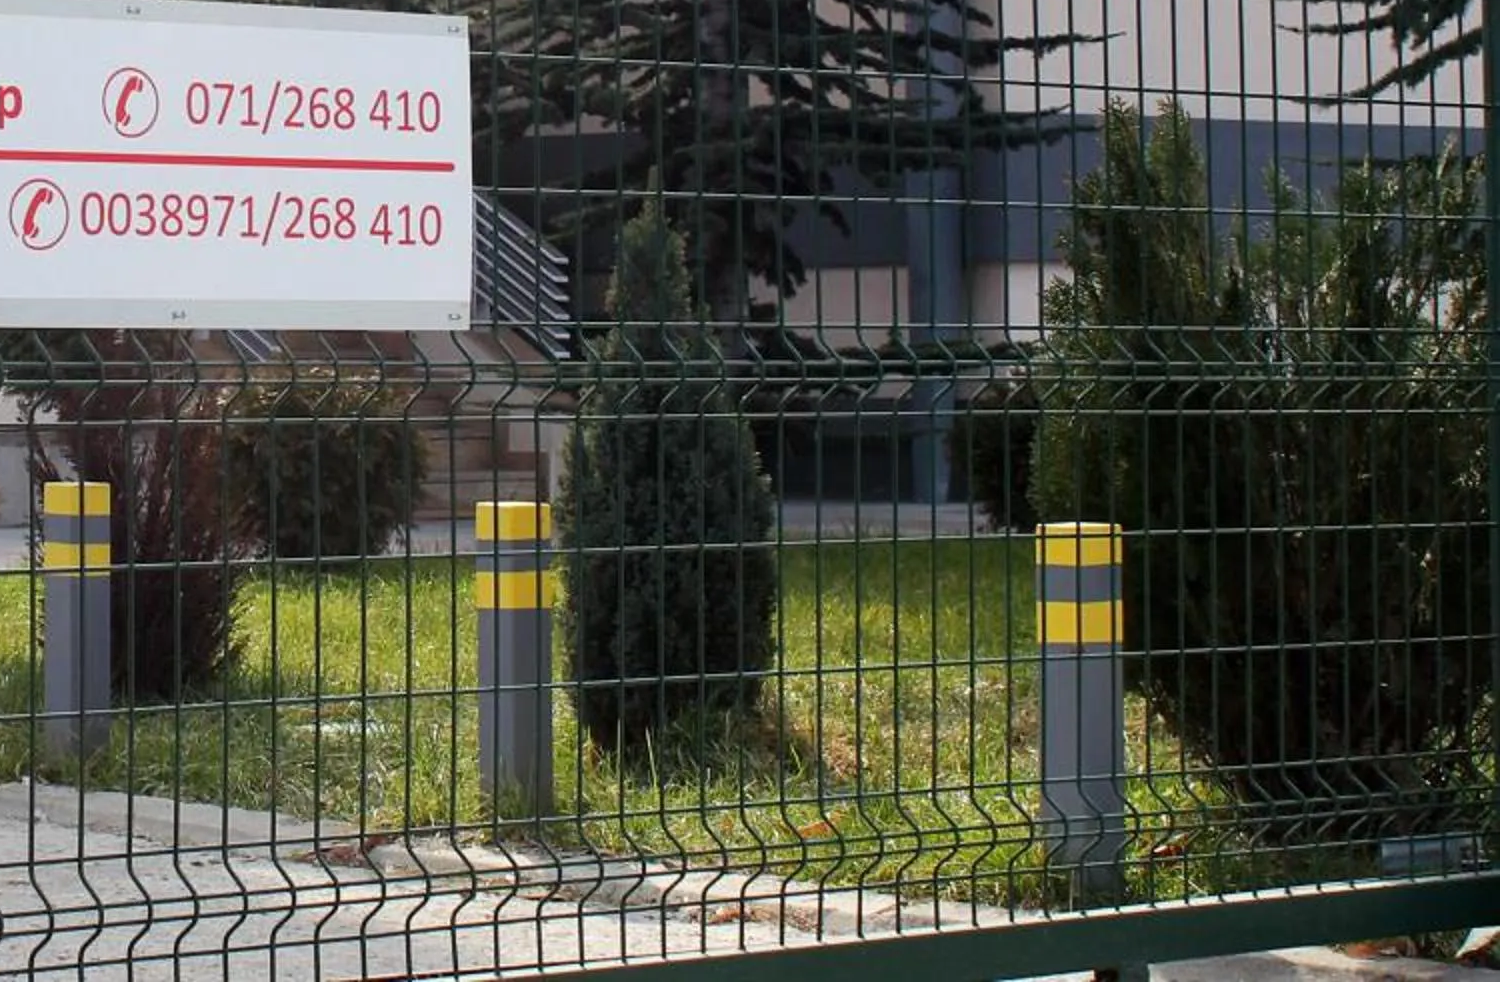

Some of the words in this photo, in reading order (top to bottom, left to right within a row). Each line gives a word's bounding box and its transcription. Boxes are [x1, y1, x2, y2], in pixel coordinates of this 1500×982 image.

[187, 80, 356, 135] 071/268
[369, 90, 442, 133] 410
[81, 191, 358, 246] 0038971/268
[369, 204, 444, 247] 410
